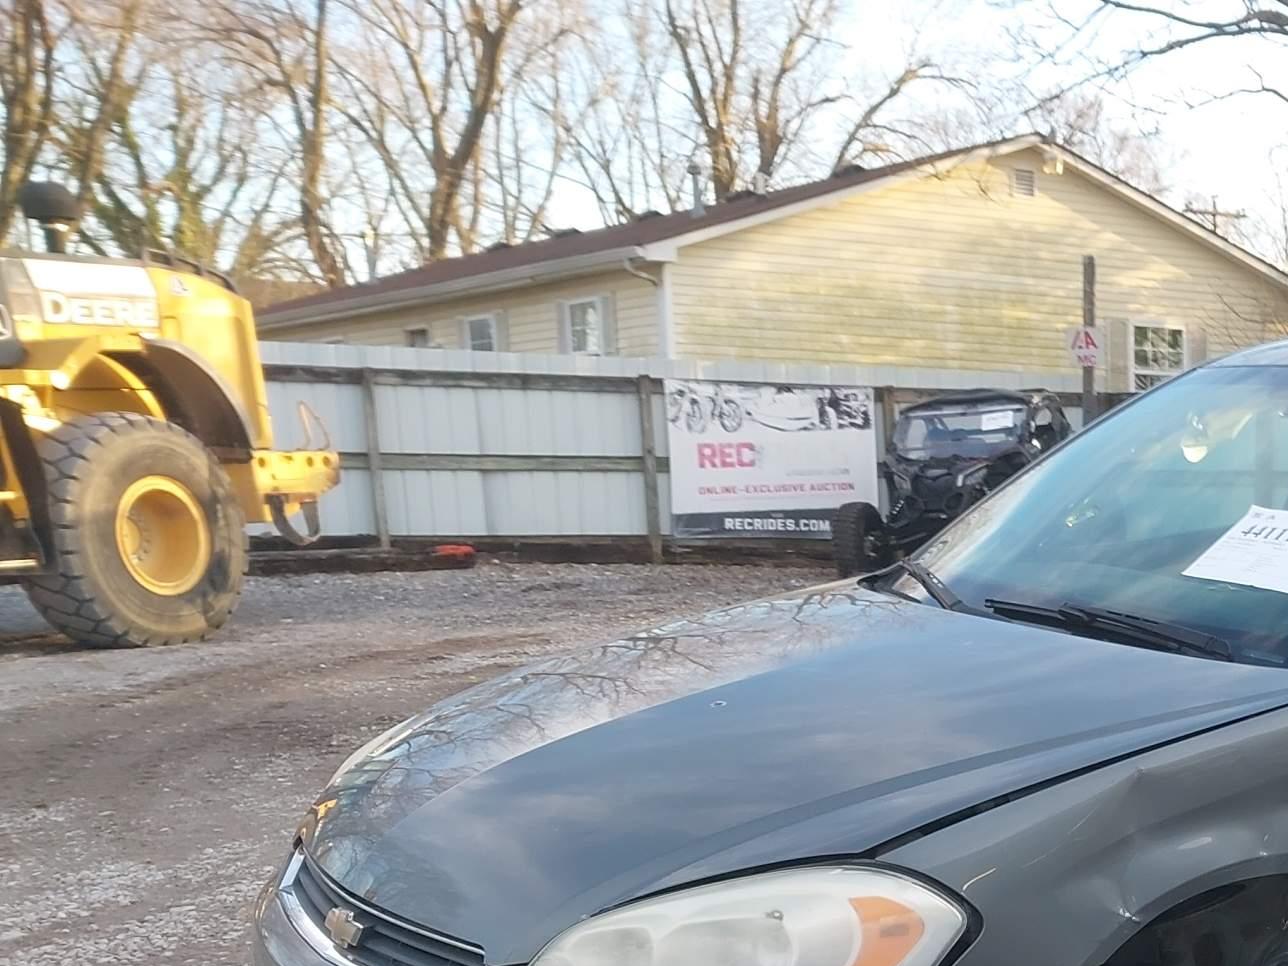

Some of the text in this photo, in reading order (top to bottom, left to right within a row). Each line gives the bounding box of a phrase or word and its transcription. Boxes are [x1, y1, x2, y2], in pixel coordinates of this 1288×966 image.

[42, 290, 159, 327] DEERE
[698, 482, 855, 495] ONLINE-EXCLUSIVE AUCTION
[724, 517, 831, 532] RECRIDES.COM
